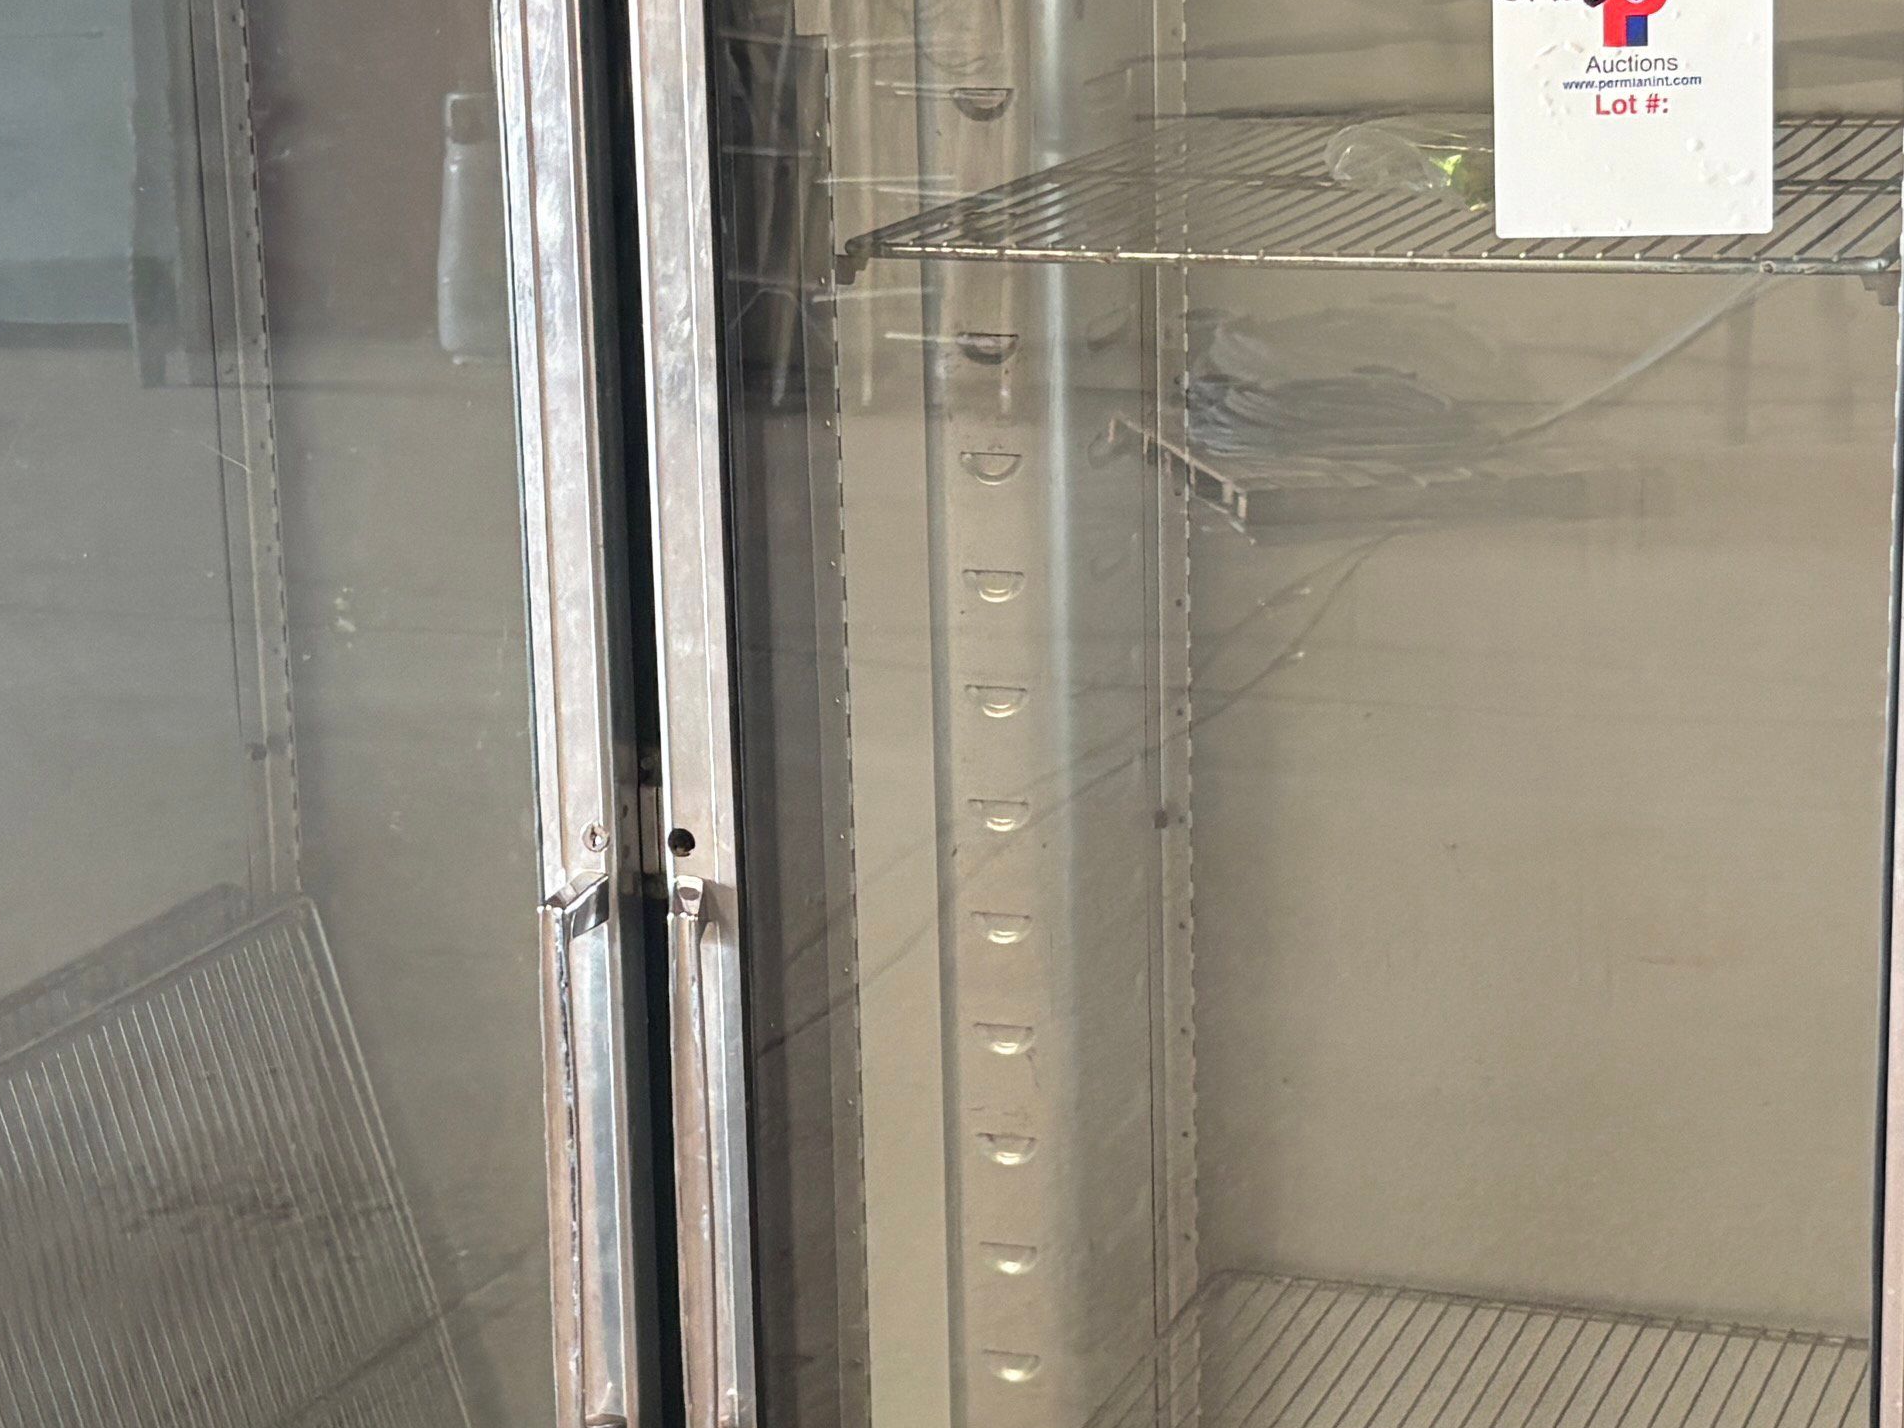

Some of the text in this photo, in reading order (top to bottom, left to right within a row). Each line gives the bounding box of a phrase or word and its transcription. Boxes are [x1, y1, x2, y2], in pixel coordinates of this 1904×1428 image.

[1585, 54, 1679, 74] Auctions
[1562, 75, 1702, 92] www.permianint.com
[1595, 92, 1669, 115] Lot #:
